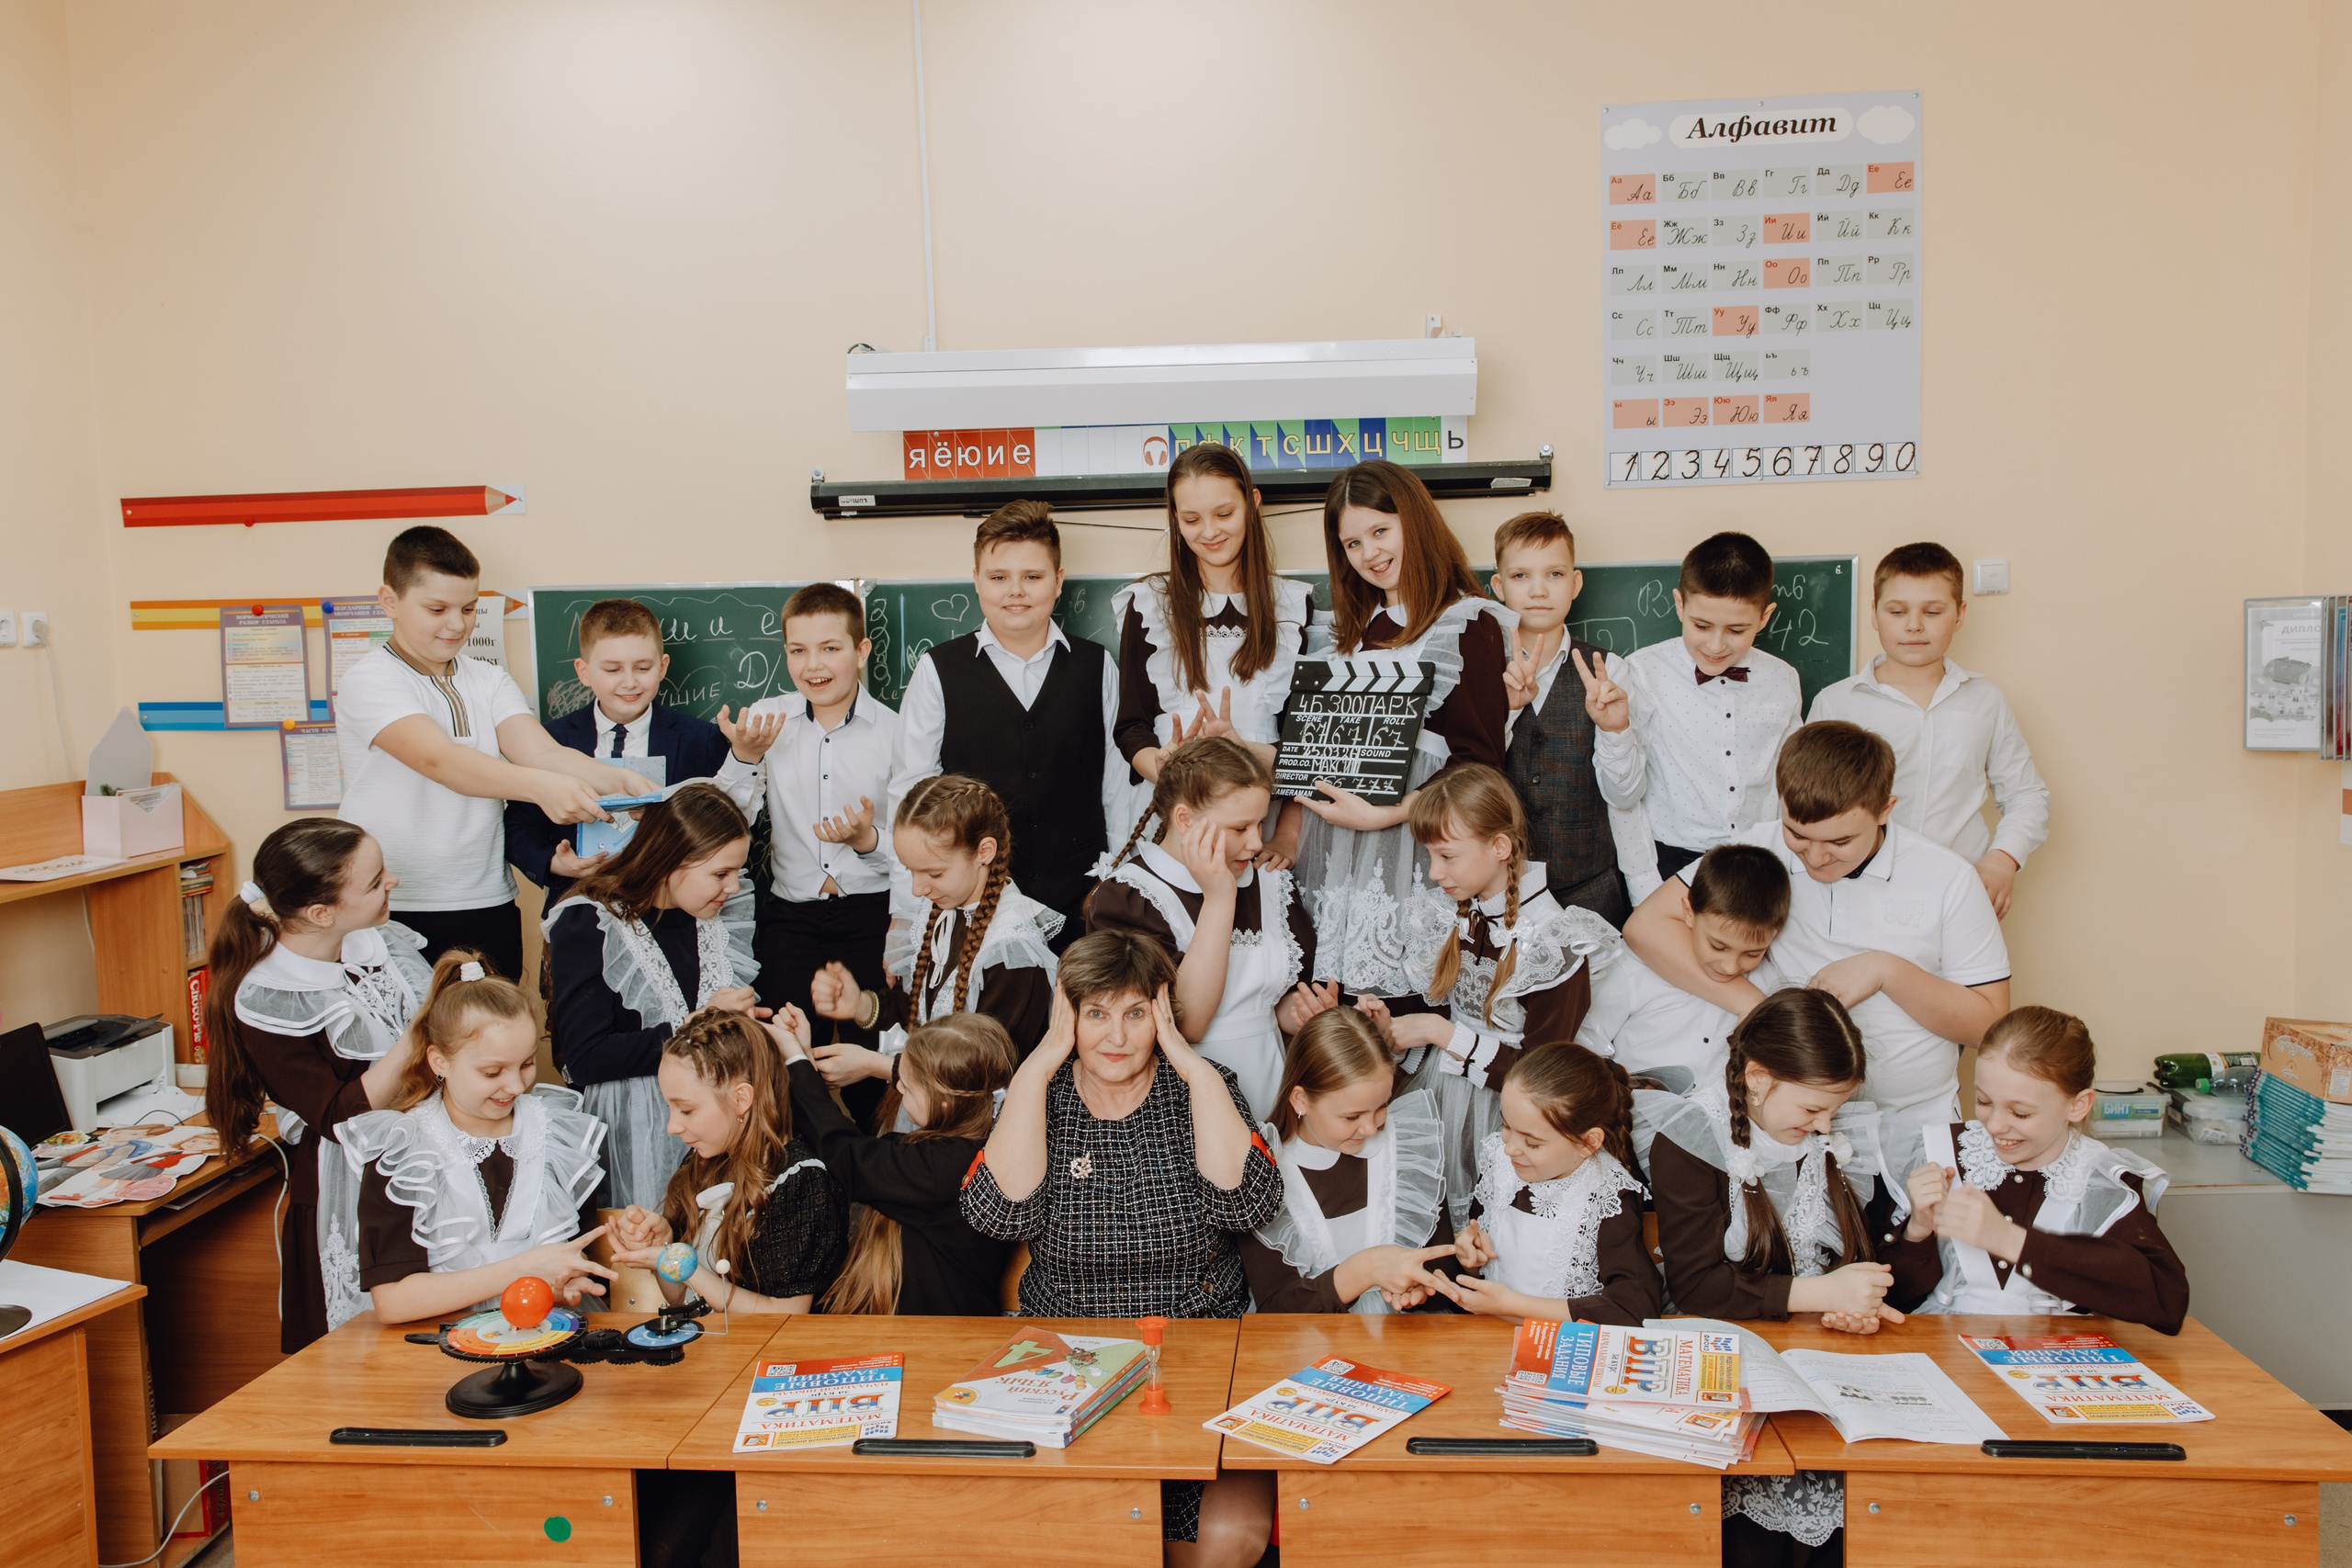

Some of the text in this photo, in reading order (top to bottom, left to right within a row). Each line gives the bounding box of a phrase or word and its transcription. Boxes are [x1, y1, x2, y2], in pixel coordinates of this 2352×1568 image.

[1685, 114, 1838, 143] Алфавит
[1611, 175, 1623, 185] Аа
[1713, 172, 1725, 180] Вв
[1817, 167, 1830, 176] Дд
[1627, 172, 1912, 201] Аа Бб Вв Гг Дд Ее
[1611, 221, 1623, 230] Ёё
[1713, 219, 1724, 227] Зз
[1764, 216, 1777, 224] Ии
[1817, 212, 1829, 222] Йй
[1869, 211, 1879, 220] Кк
[1638, 217, 1912, 248] Ёё Жж Зз Ии Йй Кк
[1611, 266, 1623, 275] Лл
[1765, 260, 1778, 268] Оо
[1817, 258, 1829, 266] Пп
[1868, 255, 1880, 265] Рр
[1627, 262, 1911, 290] Лл Мм Нн Оо Пп Рр
[1714, 308, 1724, 317] Уу
[1765, 306, 1780, 315] Фф
[1868, 301, 1881, 310] Цц
[1636, 309, 1912, 338] Сс Тт Уу Фф Хх Цц
[1664, 355, 1680, 363] Шш
[1713, 354, 1731, 363] Щщ
[1635, 366, 1654, 382] Чч
[1677, 363, 1708, 380] Шш
[1725, 361, 1758, 382] Щщ
[1664, 399, 1676, 407] Ээ
[1713, 396, 1731, 404] Юю
[1689, 407, 1708, 424] Ээ
[1730, 406, 1758, 423] Юю
[1783, 403, 1808, 421] Яя
[1299, 694, 1420, 718] 4Б ЗООПАРК
[1383, 717, 1406, 726] ROLL
[1278, 759, 1311, 767] PROD.CO.
[1360, 749, 1391, 758] SOUND
[1275, 773, 1309, 781] DIRECTOR
[992, 1339, 1055, 1369] 4
[1551, 1335, 1575, 1379] ЗАДАНИЯ
[1567, 1331, 1594, 1385] ТИПОВЫЕ
[1596, 1331, 1611, 1367] НАЧАЛЬНОЙ
[2008, 1348, 2103, 1358] ЗАДАНИЯ
[1609, 1361, 1619, 1373] курс
[1622, 1336, 1671, 1393] ВПР
[1675, 1339, 1693, 1395] МАТЕМАТИКА
[2002, 1355, 2124, 1364] ТИПОВЫЕ
[775, 1373, 888, 1390] ТИПОВЫЕ
[787, 1369, 878, 1382] ЗАДАНИЯ
[2032, 1374, 2163, 1393] ВПР
[819, 1382, 888, 1393] НАЧАЛЬНОЙ
[1007, 1387, 1080, 1401] Русский
[1308, 1377, 1408, 1409] ТИПОВЫЕ
[1329, 1374, 1410, 1402] ЗАДАНИЯ
[763, 1393, 885, 1420] ВПР
[1321, 1396, 1346, 1408] курс
[1335, 1393, 1399, 1416] НАЧАЛЬНОЙ
[2044, 1394, 2172, 1403] МАТЕМАТИКА
[761, 1414, 881, 1429] МАТЕМАТИКА
[1250, 1409, 1352, 1441] МАТЕМАТИКА
[1265, 1397, 1381, 1434] ВПР
[1322, 1441, 1348, 1450] ФИОКО
